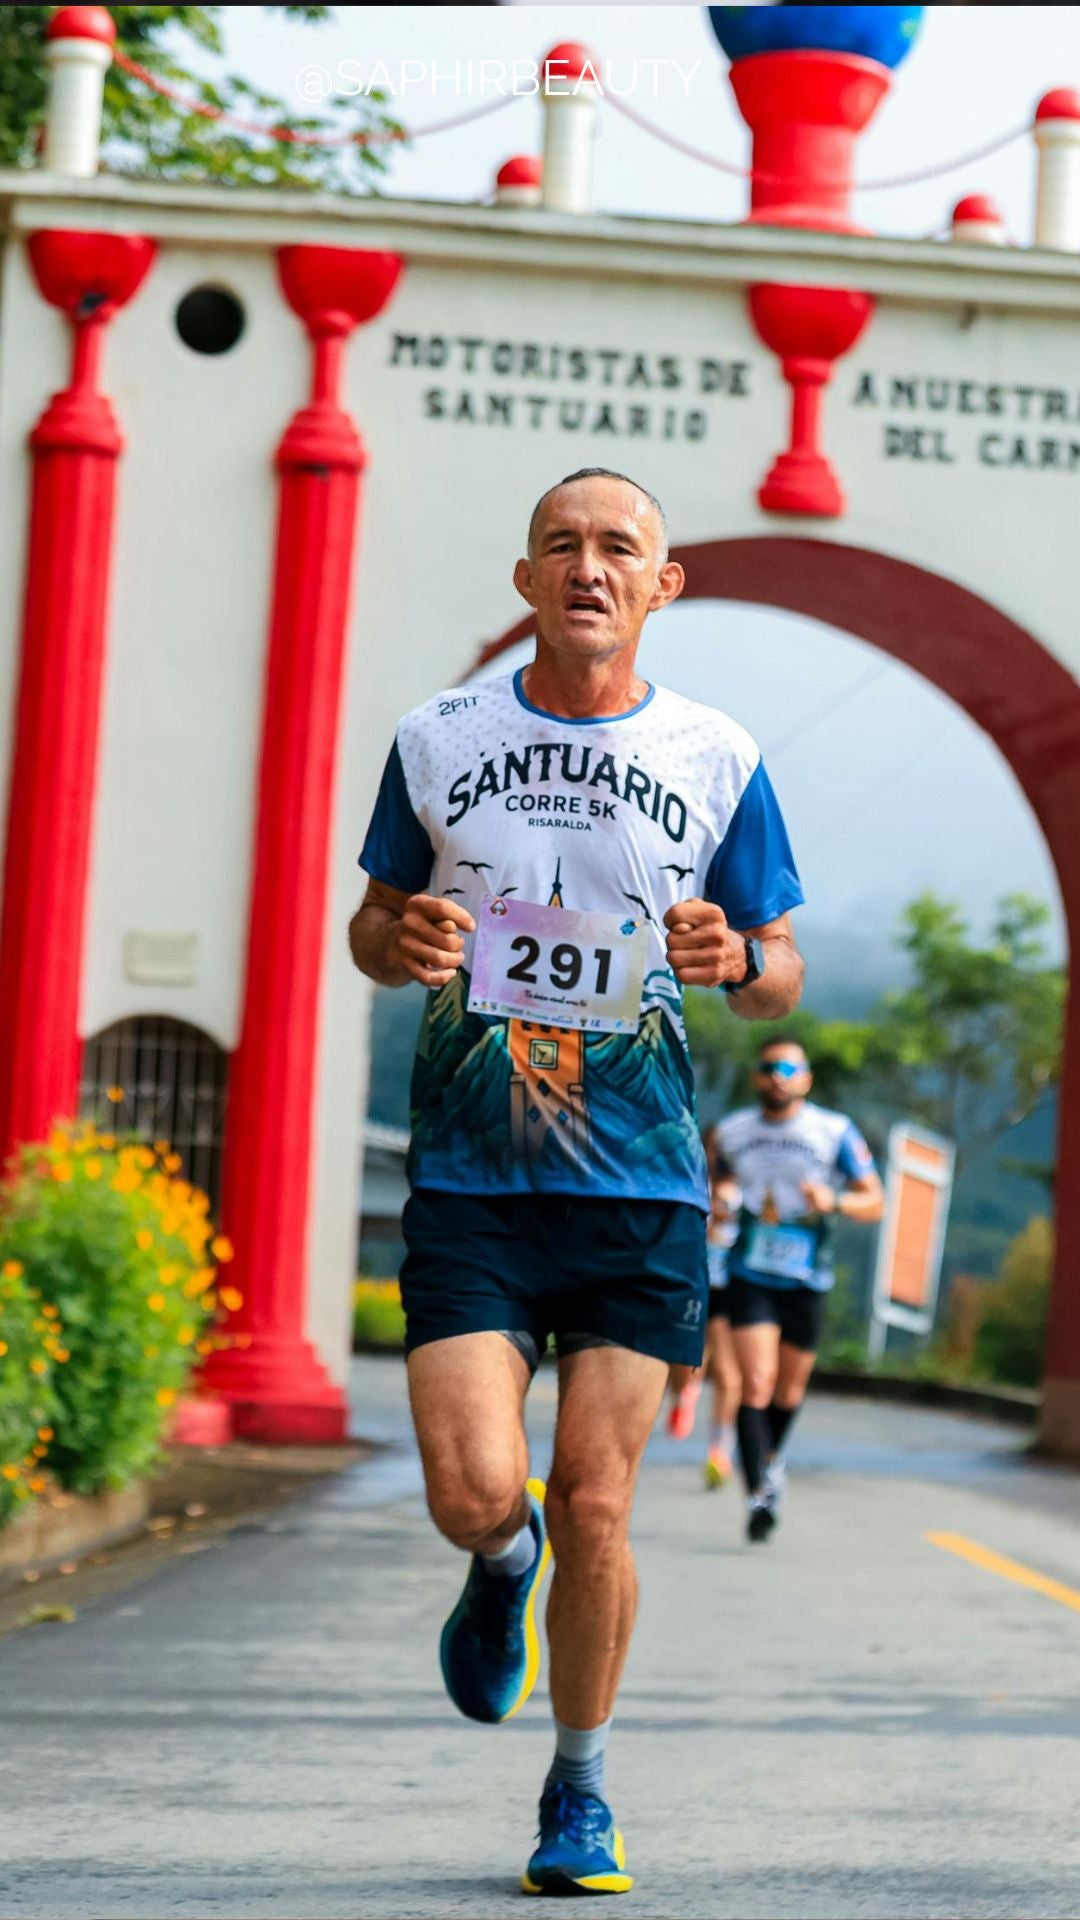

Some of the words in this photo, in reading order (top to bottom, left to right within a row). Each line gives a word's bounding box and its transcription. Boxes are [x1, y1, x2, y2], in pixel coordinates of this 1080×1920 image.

[389, 333, 683, 390] MOTORISTAS
[699, 359, 751, 396] DE
[423, 386, 708, 442] SANTUARIO
[890, 375, 1080, 422] NUESTR
[884, 423, 953, 464] DEL
[438, 695, 480, 716] 2FIT
[445, 742, 688, 843] SANTUARIO
[505, 794, 582, 813] CORRE
[588, 800, 618, 820] 5K
[528, 817, 593, 831] RISARALDA
[506, 935, 612, 995] 291
